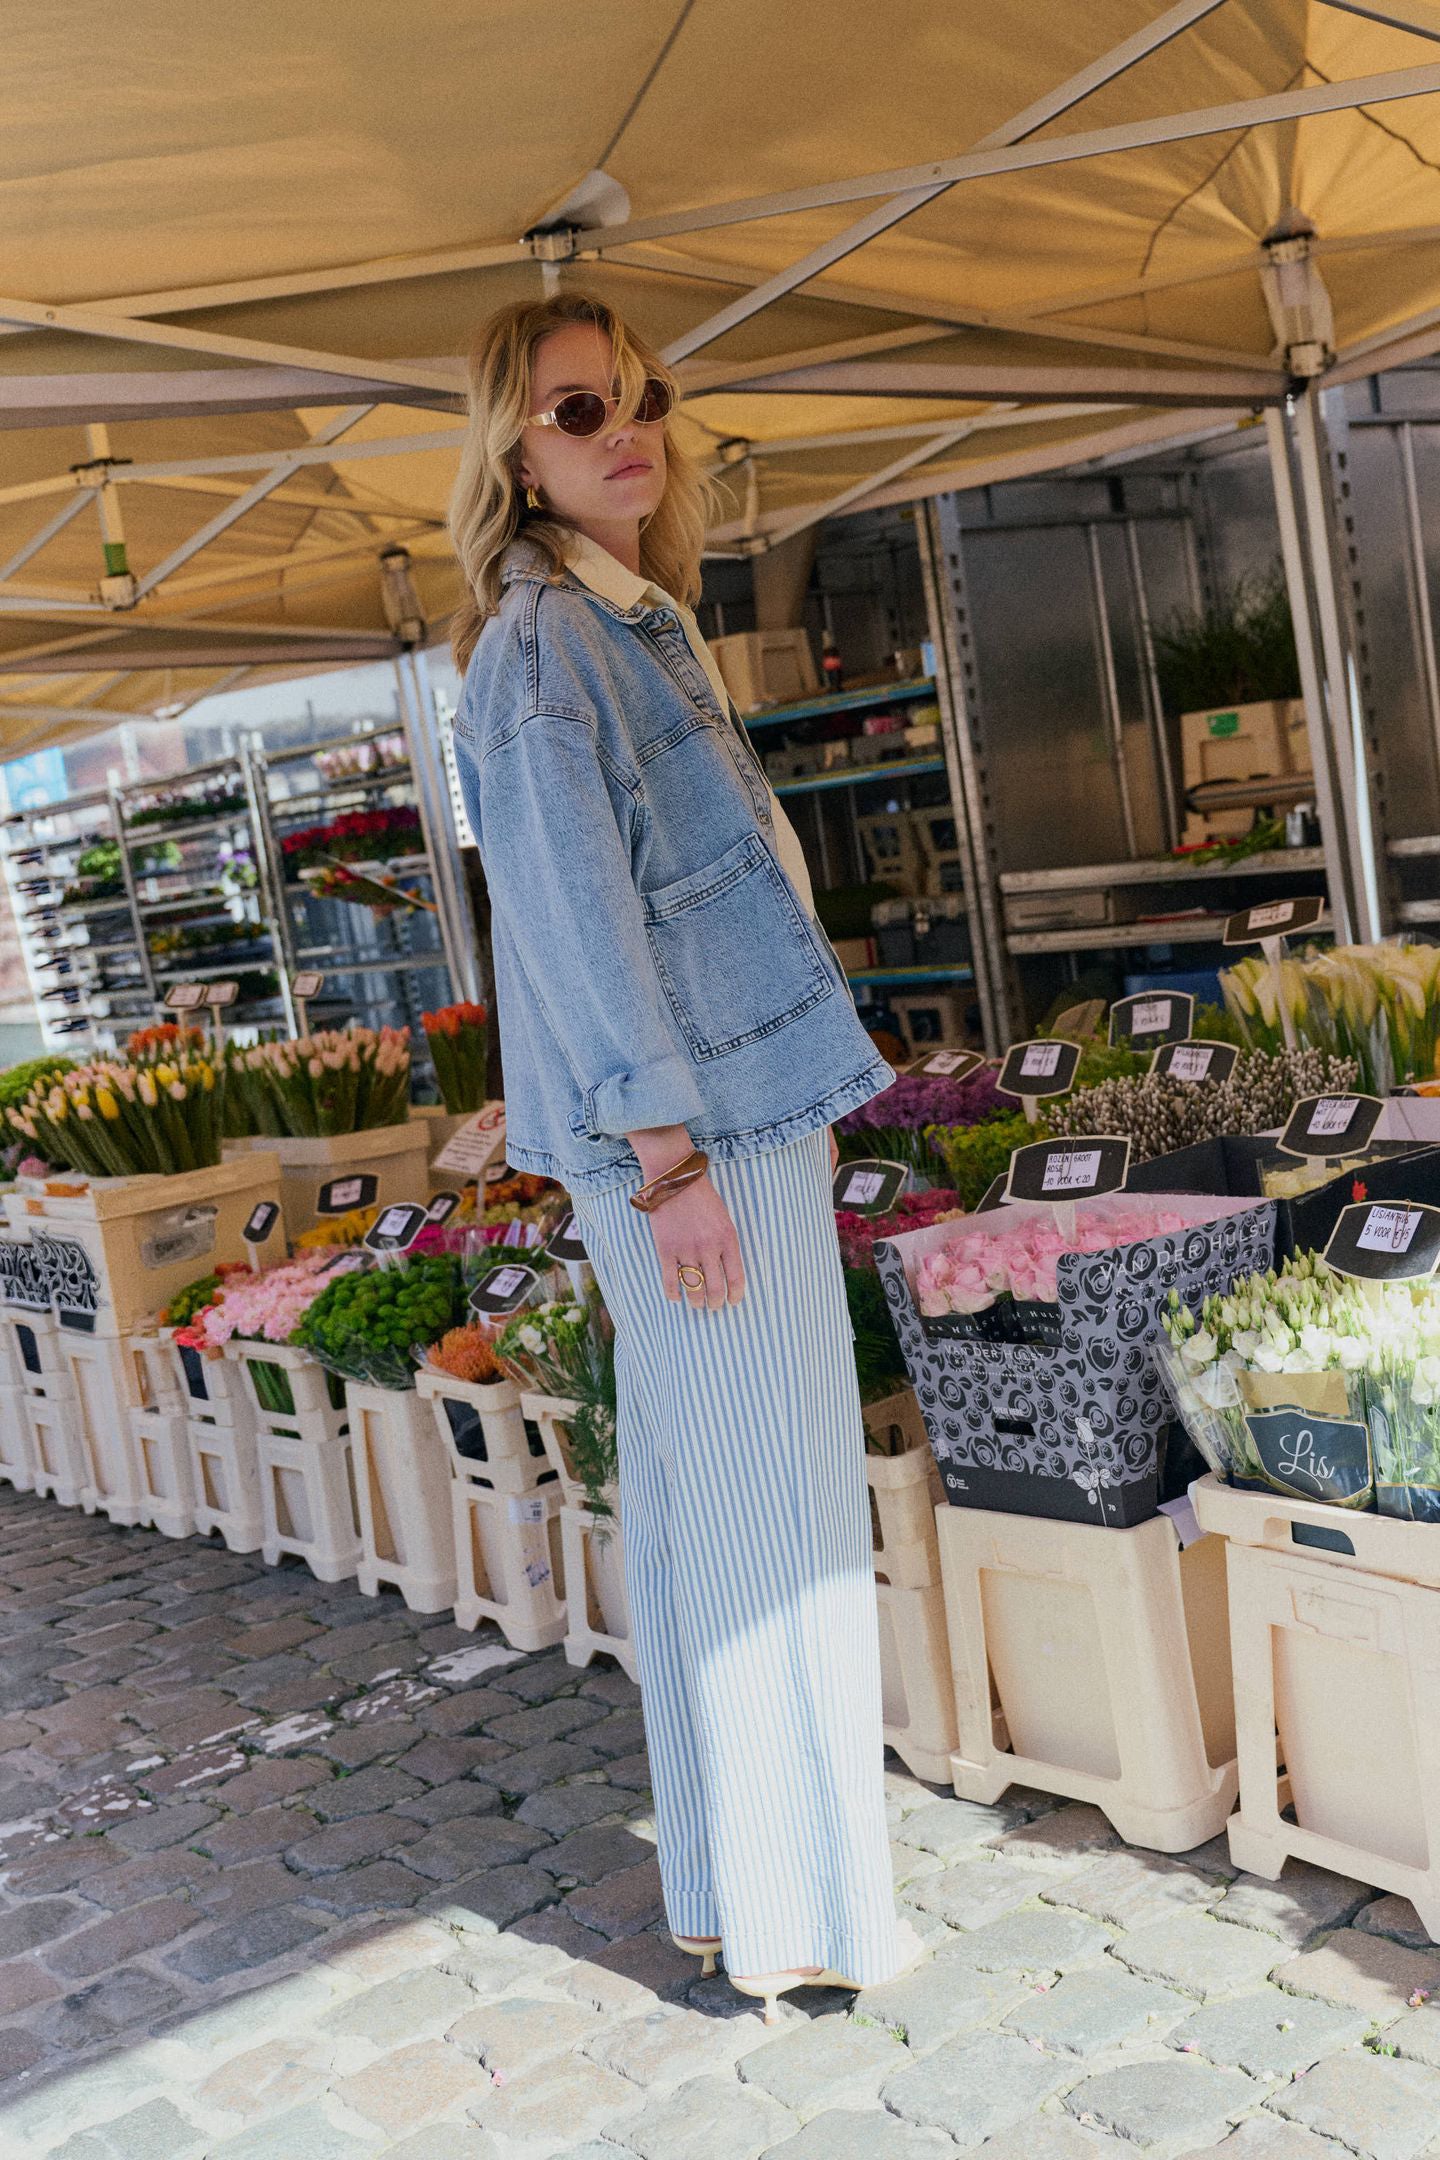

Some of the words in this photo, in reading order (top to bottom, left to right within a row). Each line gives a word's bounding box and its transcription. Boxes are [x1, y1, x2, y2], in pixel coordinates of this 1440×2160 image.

[1049, 1155, 1069, 1164] ROZEN
[1074, 1153, 1092, 1162] GROOT
[1057, 1175, 1073, 1186] VOOR
[1364, 1224, 1373, 1236] 5
[1374, 1225, 1391, 1239] VOOR
[1100, 1258, 1145, 1280] VAN
[1157, 1244, 1200, 1267] DER
[1210, 1219, 1269, 1251] HULST
[944, 1344, 968, 1357] VAN
[974, 1348, 998, 1359] DER
[1004, 1349, 1044, 1362] HULST
[1278, 1430, 1335, 1491] Lis
